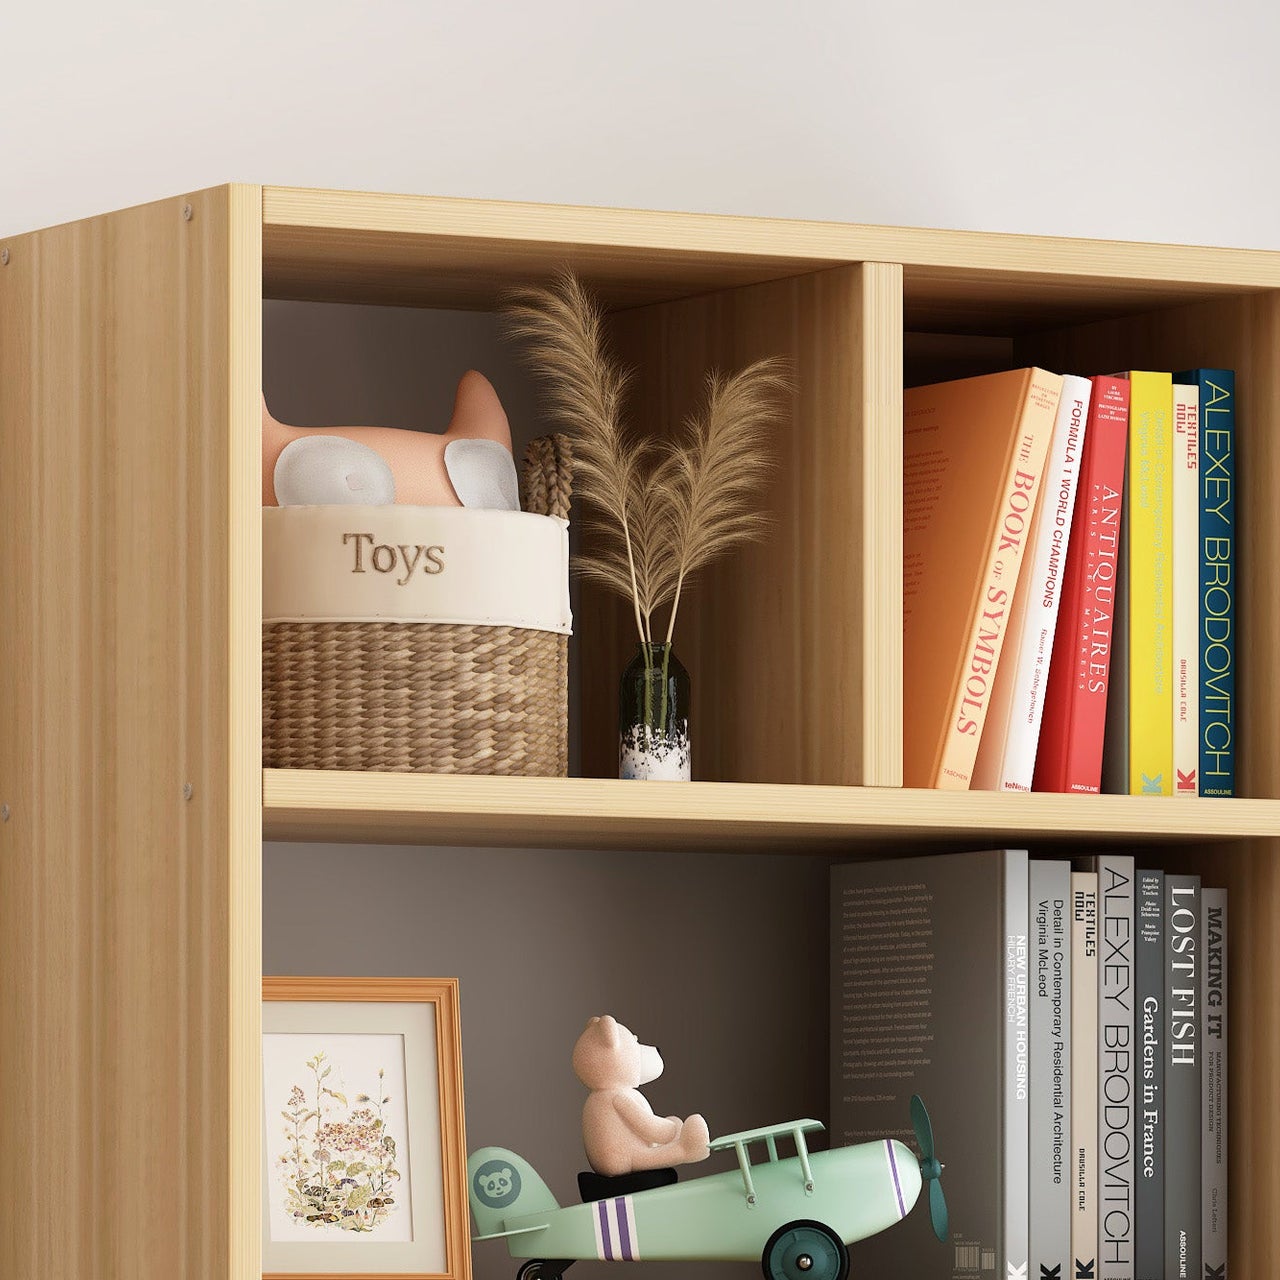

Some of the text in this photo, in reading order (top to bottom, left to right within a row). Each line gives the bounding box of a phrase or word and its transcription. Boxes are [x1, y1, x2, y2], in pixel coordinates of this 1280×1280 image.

[1019, 434, 1034, 464] THE
[1065, 399, 1083, 463] FORMULA
[1188, 405, 1197, 469] TEXTILES
[998, 470, 1035, 555] BOOK
[1055, 478, 1072, 527] WORLD
[343, 533, 446, 586] Toys
[1043, 530, 1063, 608] CHAMPIONS
[1079, 484, 1100, 689] PARIS FLEA MARKETS
[1088, 485, 1120, 694] ANTIQUAIRES
[1204, 380, 1231, 775] ALEXEY BRODOVITCH
[956, 586, 1008, 736] SYMBOLS
[1071, 784, 1099, 793] ASSOULINE
[1036, 900, 1049, 997] Virginia McLeod
[1085, 892, 1095, 957] TEXTILES
[1207, 907, 1222, 1039] MAKING IT
[1016, 935, 1026, 1100] NEW URBAN HOUSING
[1172, 886, 1195, 1066] LOST FISH
[1051, 899, 1064, 1184] Detail in Contemporary Residential Architecture
[1104, 867, 1130, 1263] ALEXEY BRODOVITCH
[1143, 996, 1158, 1178] Gardens in France
[1179, 1230, 1187, 1278] ASSOULINE
